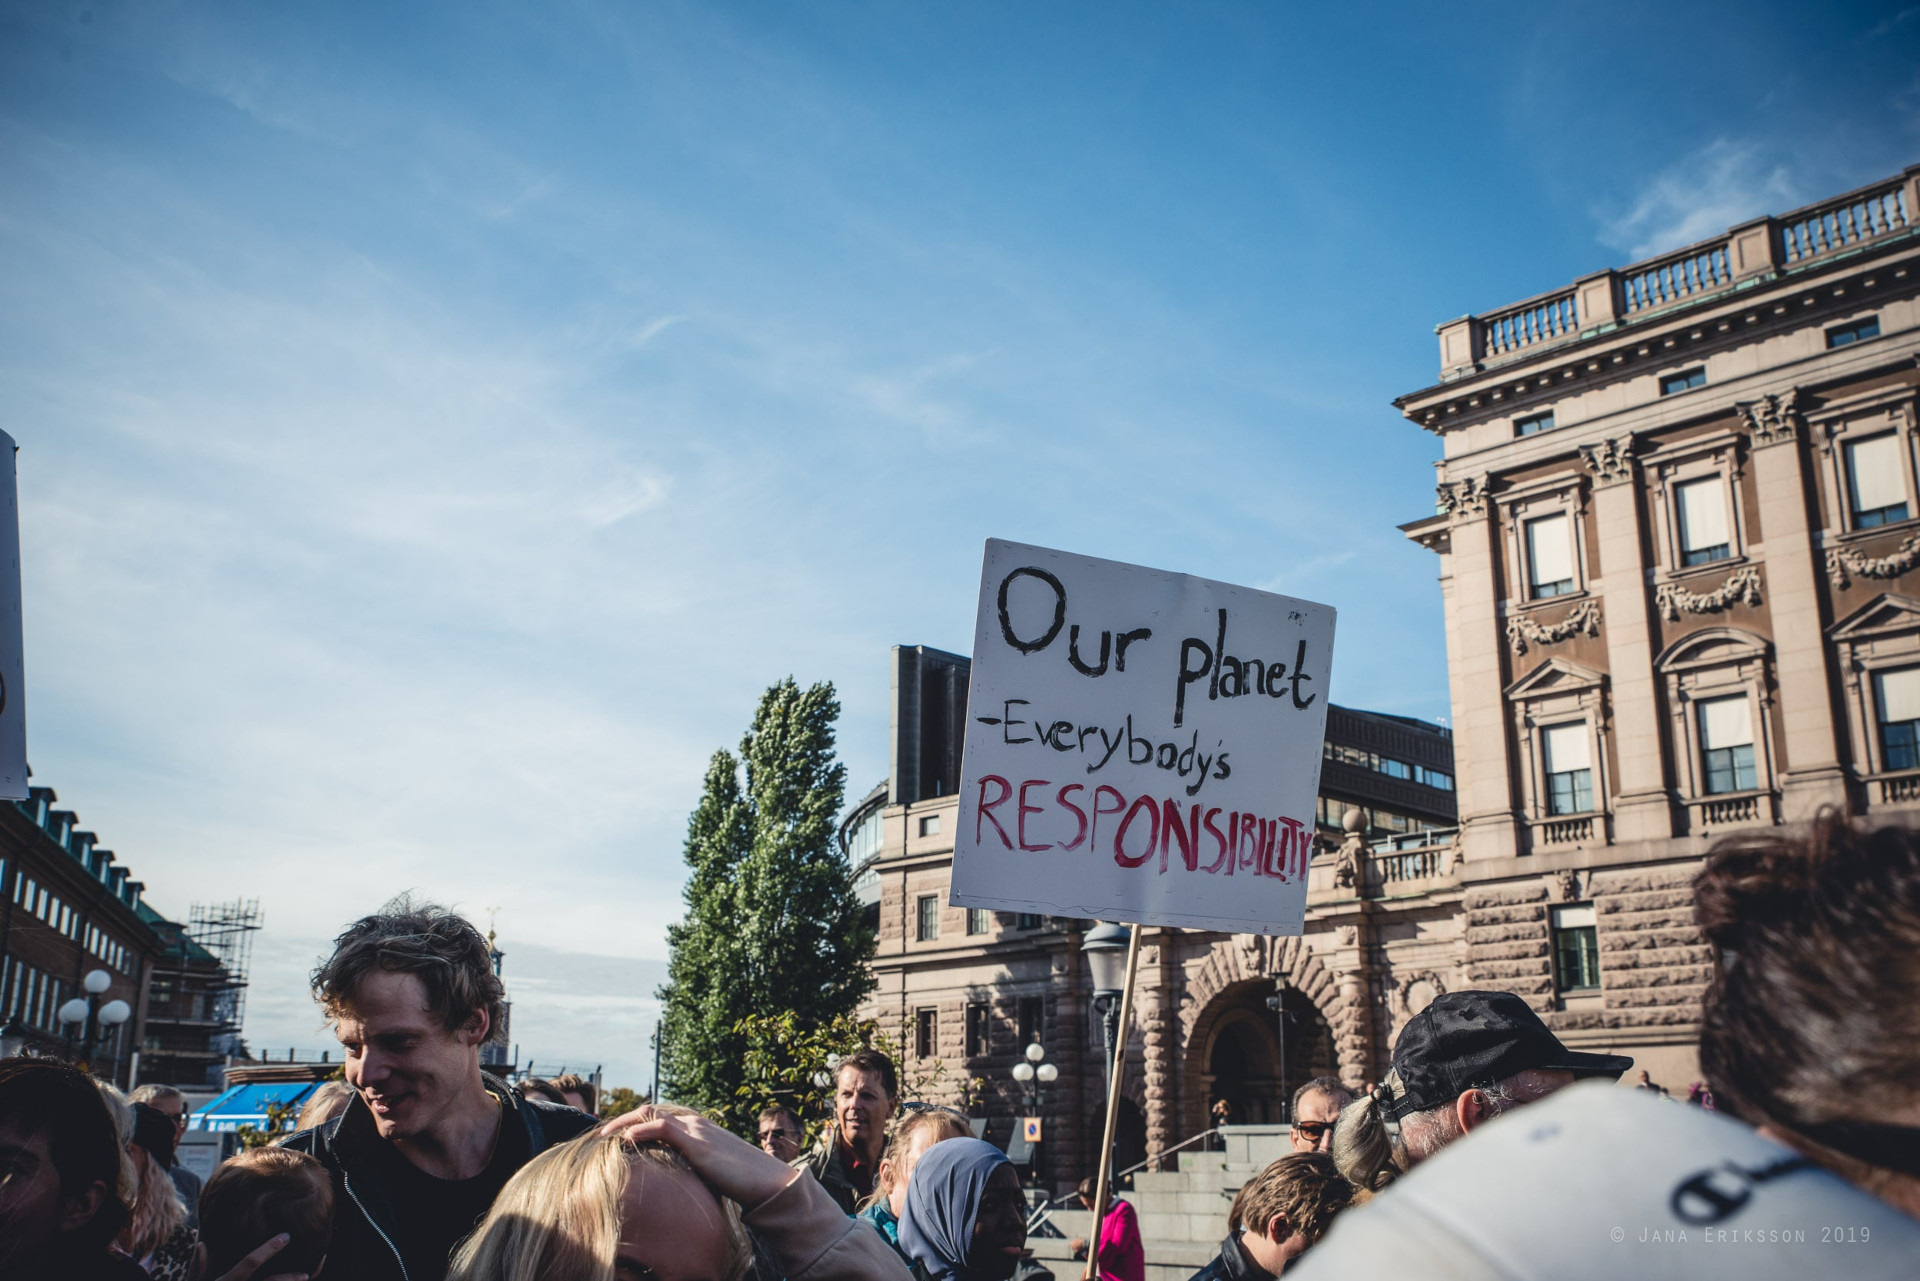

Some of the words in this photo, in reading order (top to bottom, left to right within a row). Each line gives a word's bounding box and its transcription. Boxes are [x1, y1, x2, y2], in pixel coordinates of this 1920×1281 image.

[997, 566, 1152, 678] Our
[1173, 608, 1316, 728] planet
[976, 774, 1313, 884] RESPONSIBILITY
